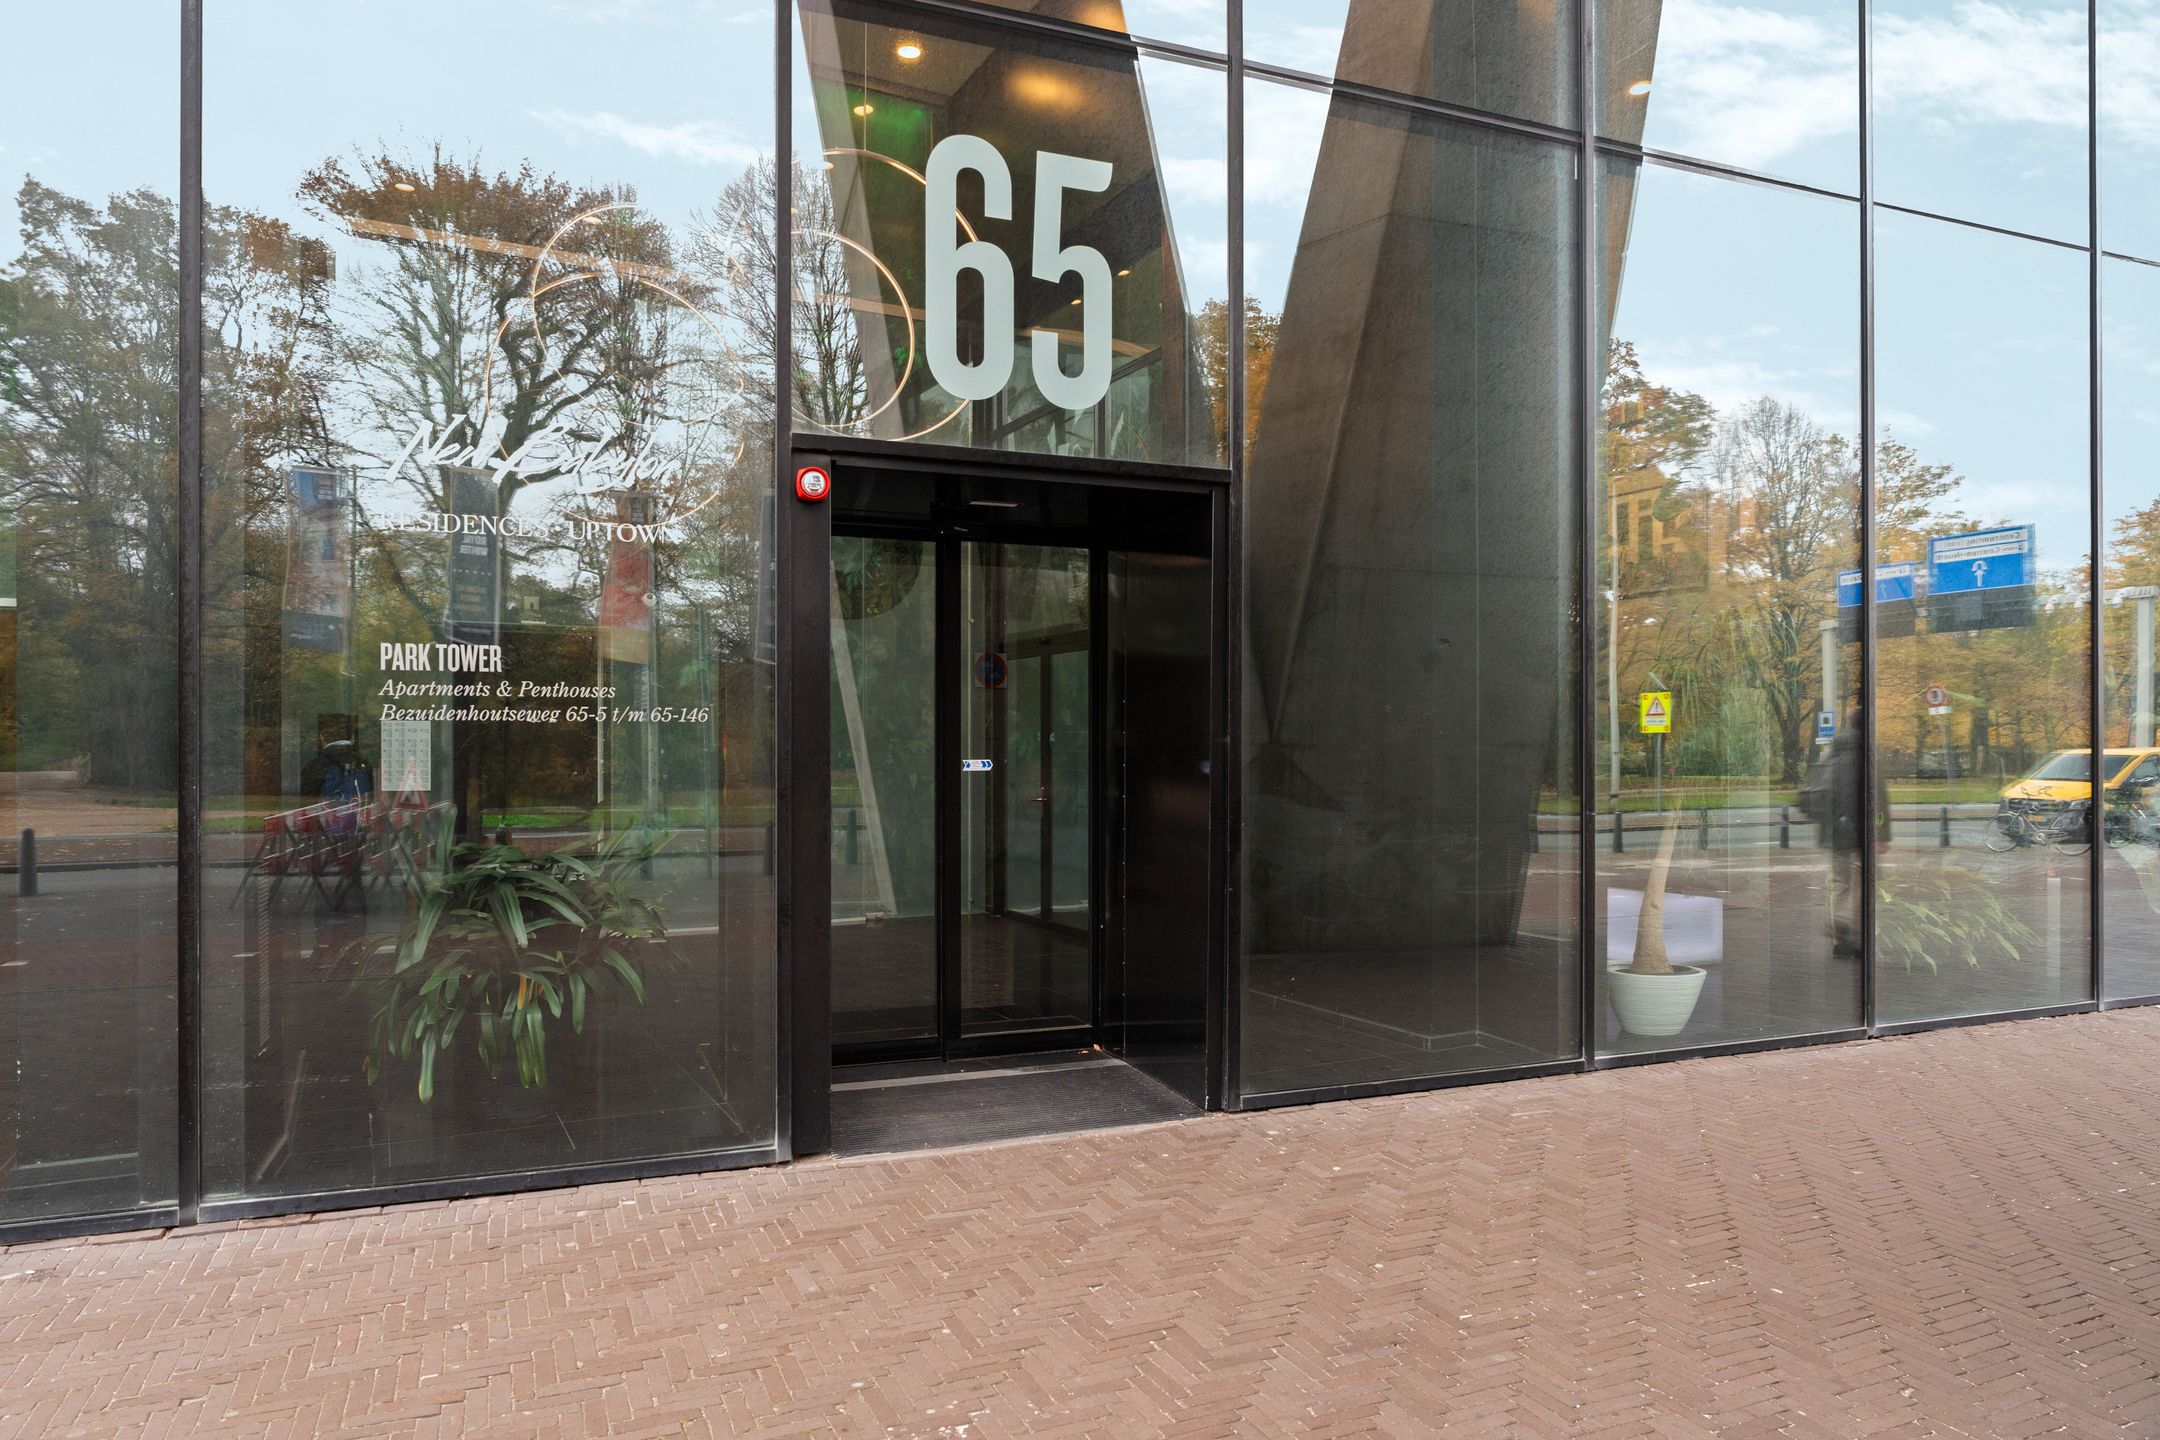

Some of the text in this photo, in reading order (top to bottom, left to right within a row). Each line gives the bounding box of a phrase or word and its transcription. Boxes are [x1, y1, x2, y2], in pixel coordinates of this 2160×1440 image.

[925, 134, 1113, 410] 65
[492, 414, 683, 495] Babylon
[377, 511, 684, 545] RESIDENCES UPTOWN
[380, 642, 503, 673] PARK TOWER
[378, 679, 616, 699] Apartments & Penthouses
[379, 703, 709, 724] Bezuidenhoutseweg 65-5 t/m 65-146
